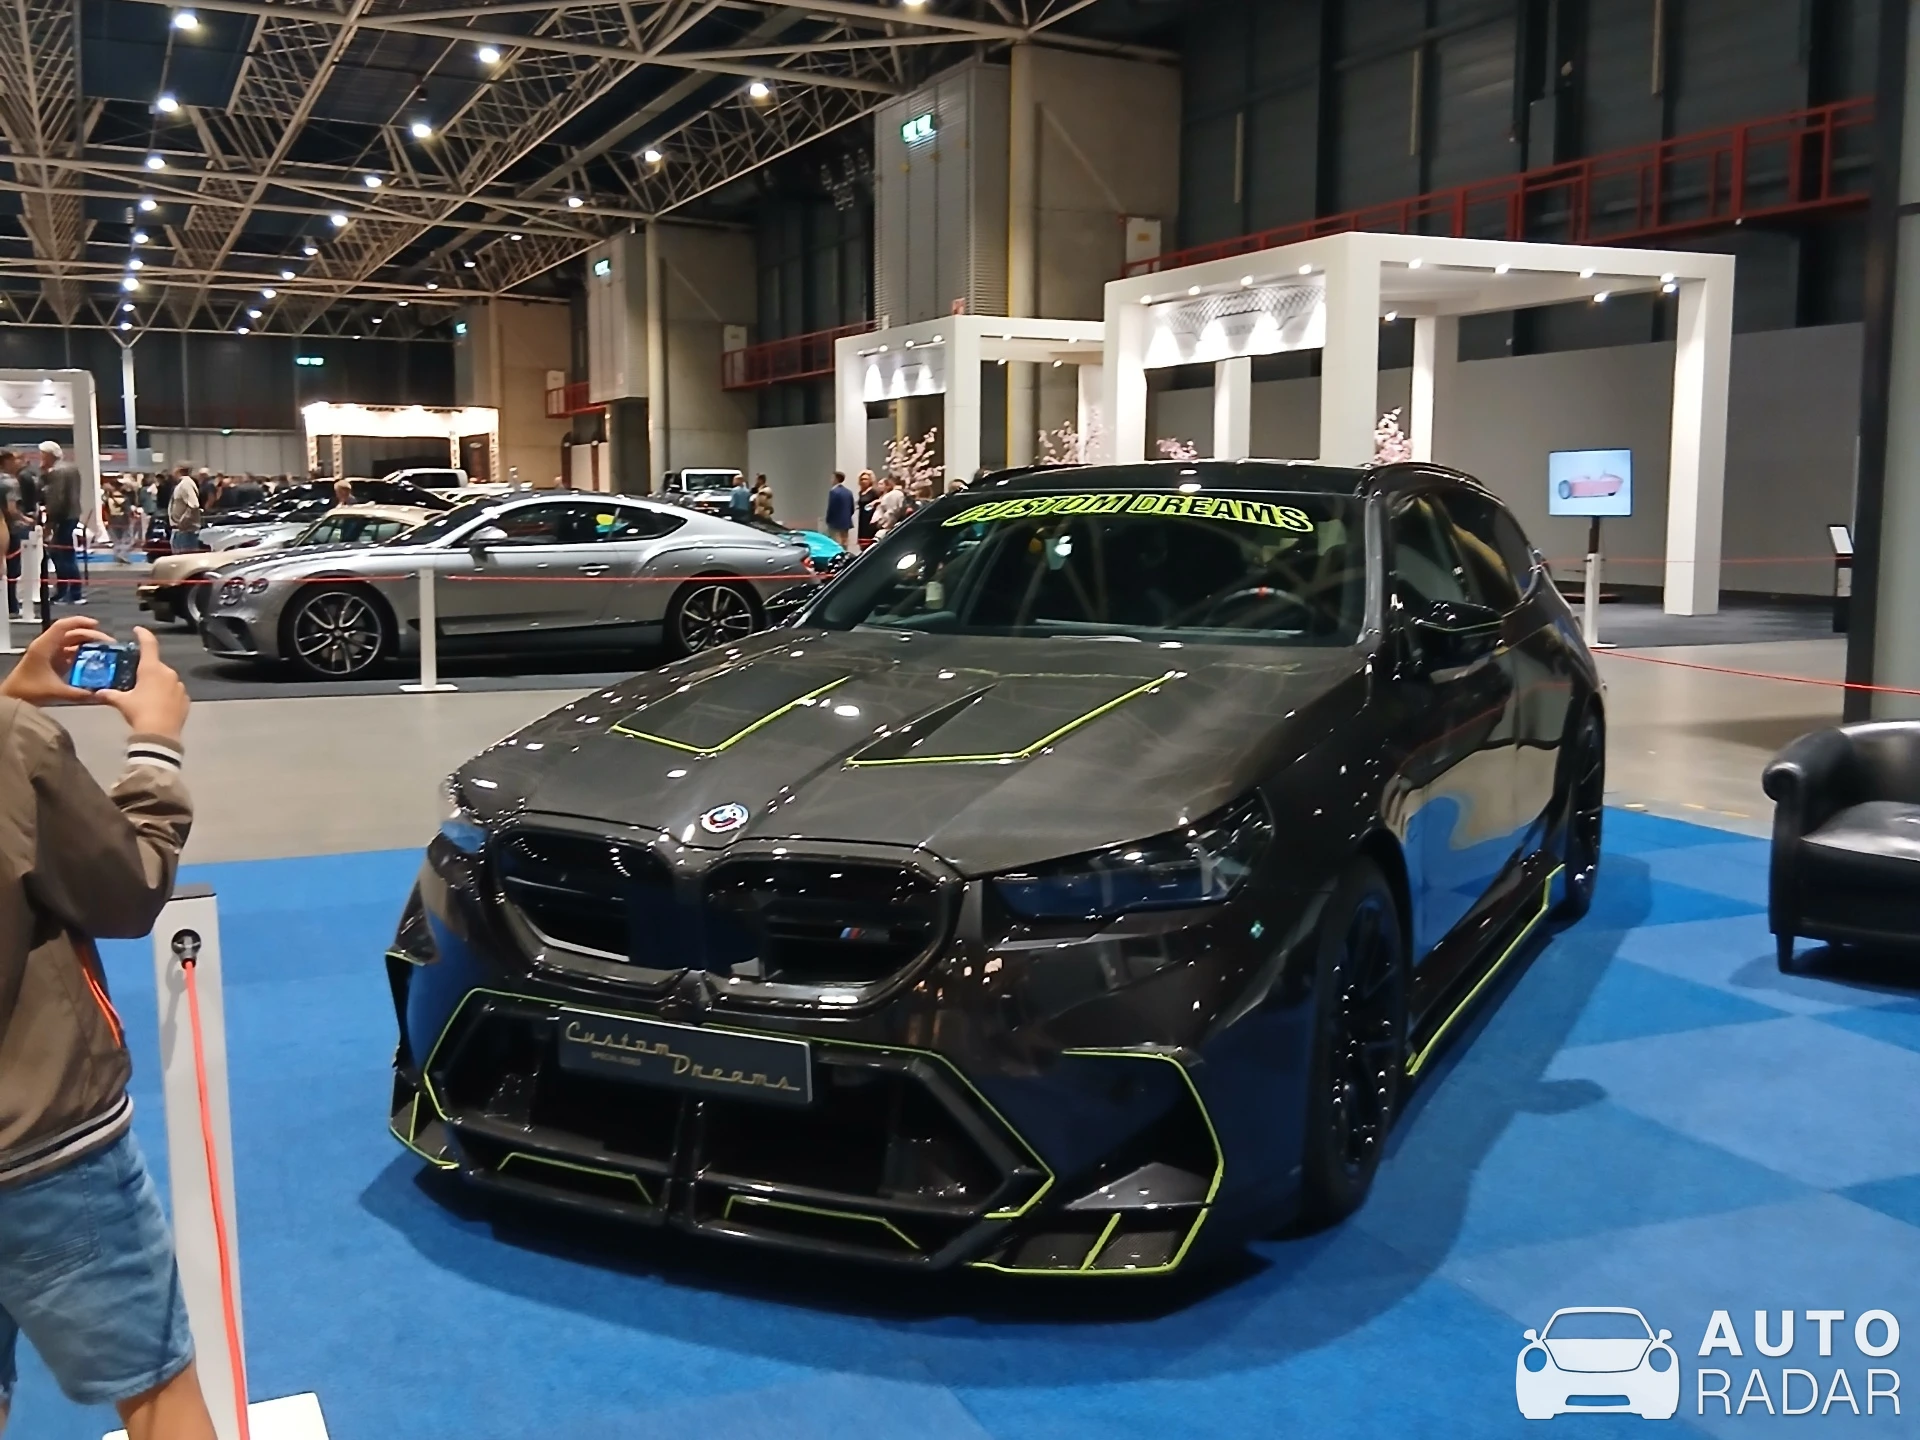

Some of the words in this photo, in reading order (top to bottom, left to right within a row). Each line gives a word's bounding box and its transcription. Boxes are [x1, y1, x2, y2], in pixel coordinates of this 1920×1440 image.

[942, 494, 1132, 527] CUSTOM
[1127, 493, 1314, 532] DREAMS
[566, 1022, 671, 1055] Custom
[673, 1054, 800, 1091] Dreams
